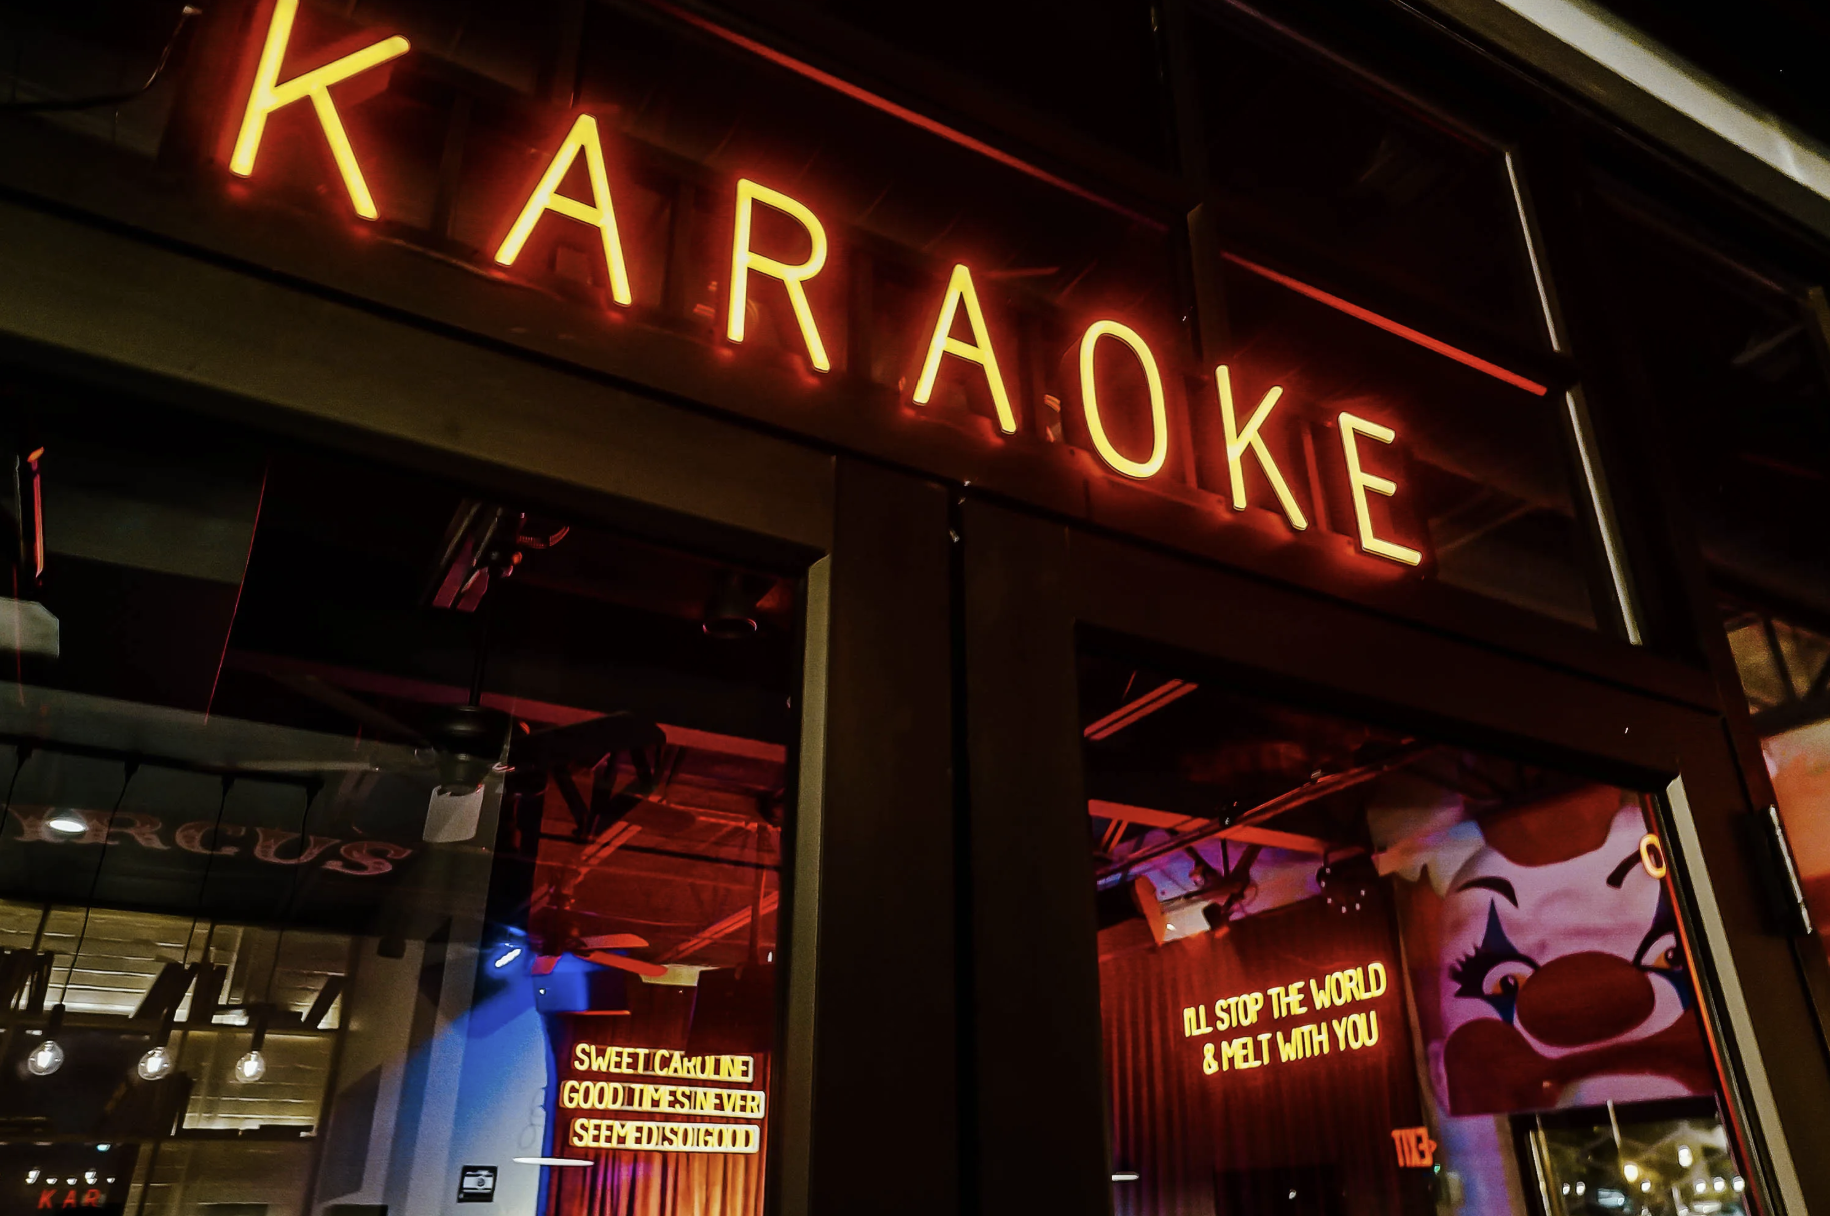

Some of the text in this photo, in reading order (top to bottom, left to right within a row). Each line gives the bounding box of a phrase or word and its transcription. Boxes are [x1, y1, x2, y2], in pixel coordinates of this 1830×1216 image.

[229, 0, 1422, 566] KARAOKE
[1214, 992, 1264, 1031] STOP
[1267, 981, 1308, 1020] THE
[1309, 961, 1388, 1010] WORLD
[573, 1043, 752, 1081] SWEET CAROLINE
[1203, 1010, 1380, 1075] & MELT WITH YOU
[562, 1080, 761, 1115] GOOD TIMES NEVER
[572, 1118, 755, 1150] SEEMED SO GOOD
